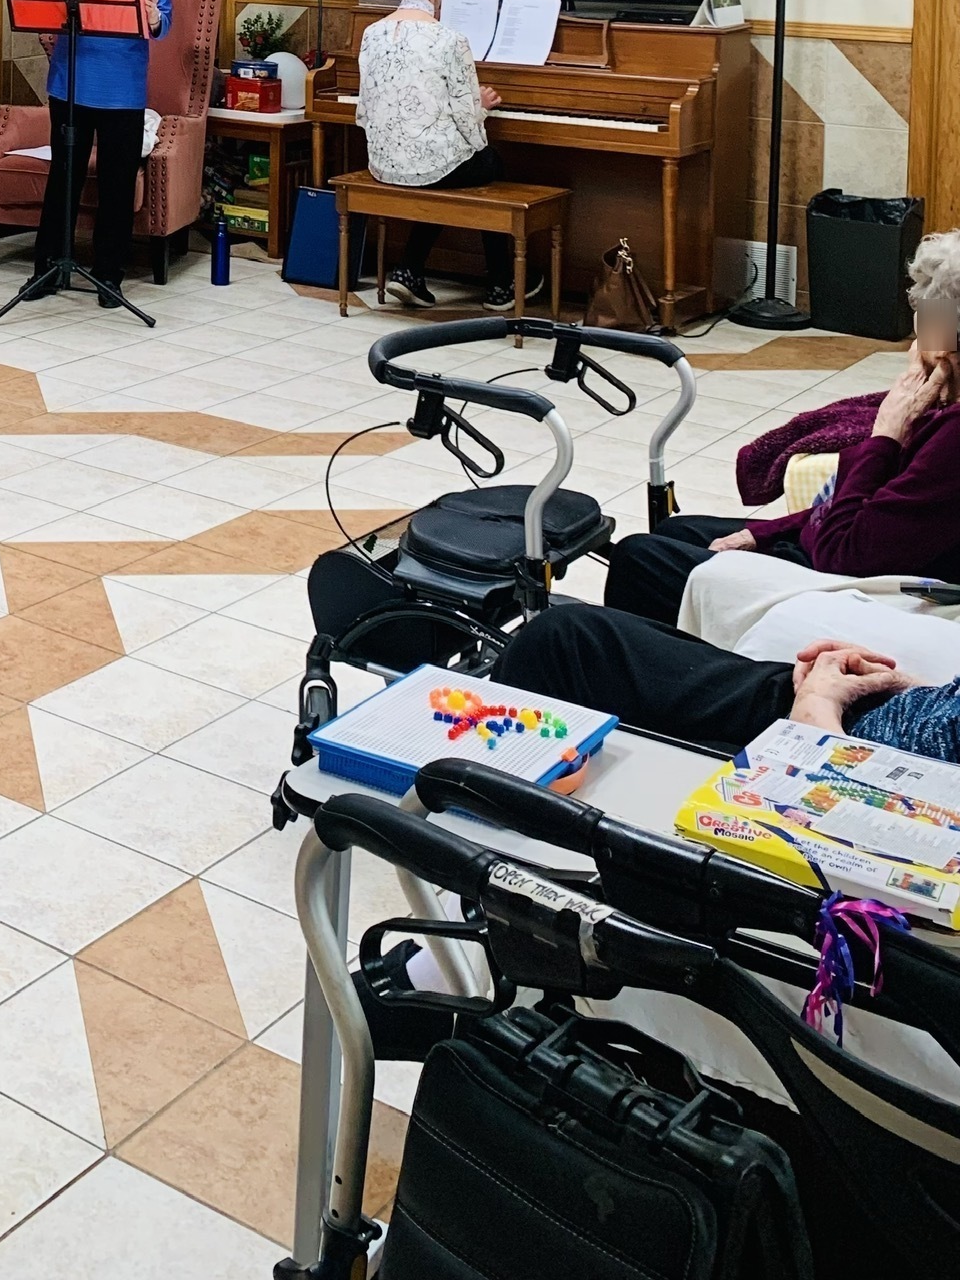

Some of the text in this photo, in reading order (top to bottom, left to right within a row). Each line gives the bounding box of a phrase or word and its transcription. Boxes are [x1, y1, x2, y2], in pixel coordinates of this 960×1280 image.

[794, 838, 871, 865] Let the children
[803, 853, 852, 873] their own!
[835, 857, 863, 869] realm
[493, 865, 605, 922] OPEN THEN WALK
